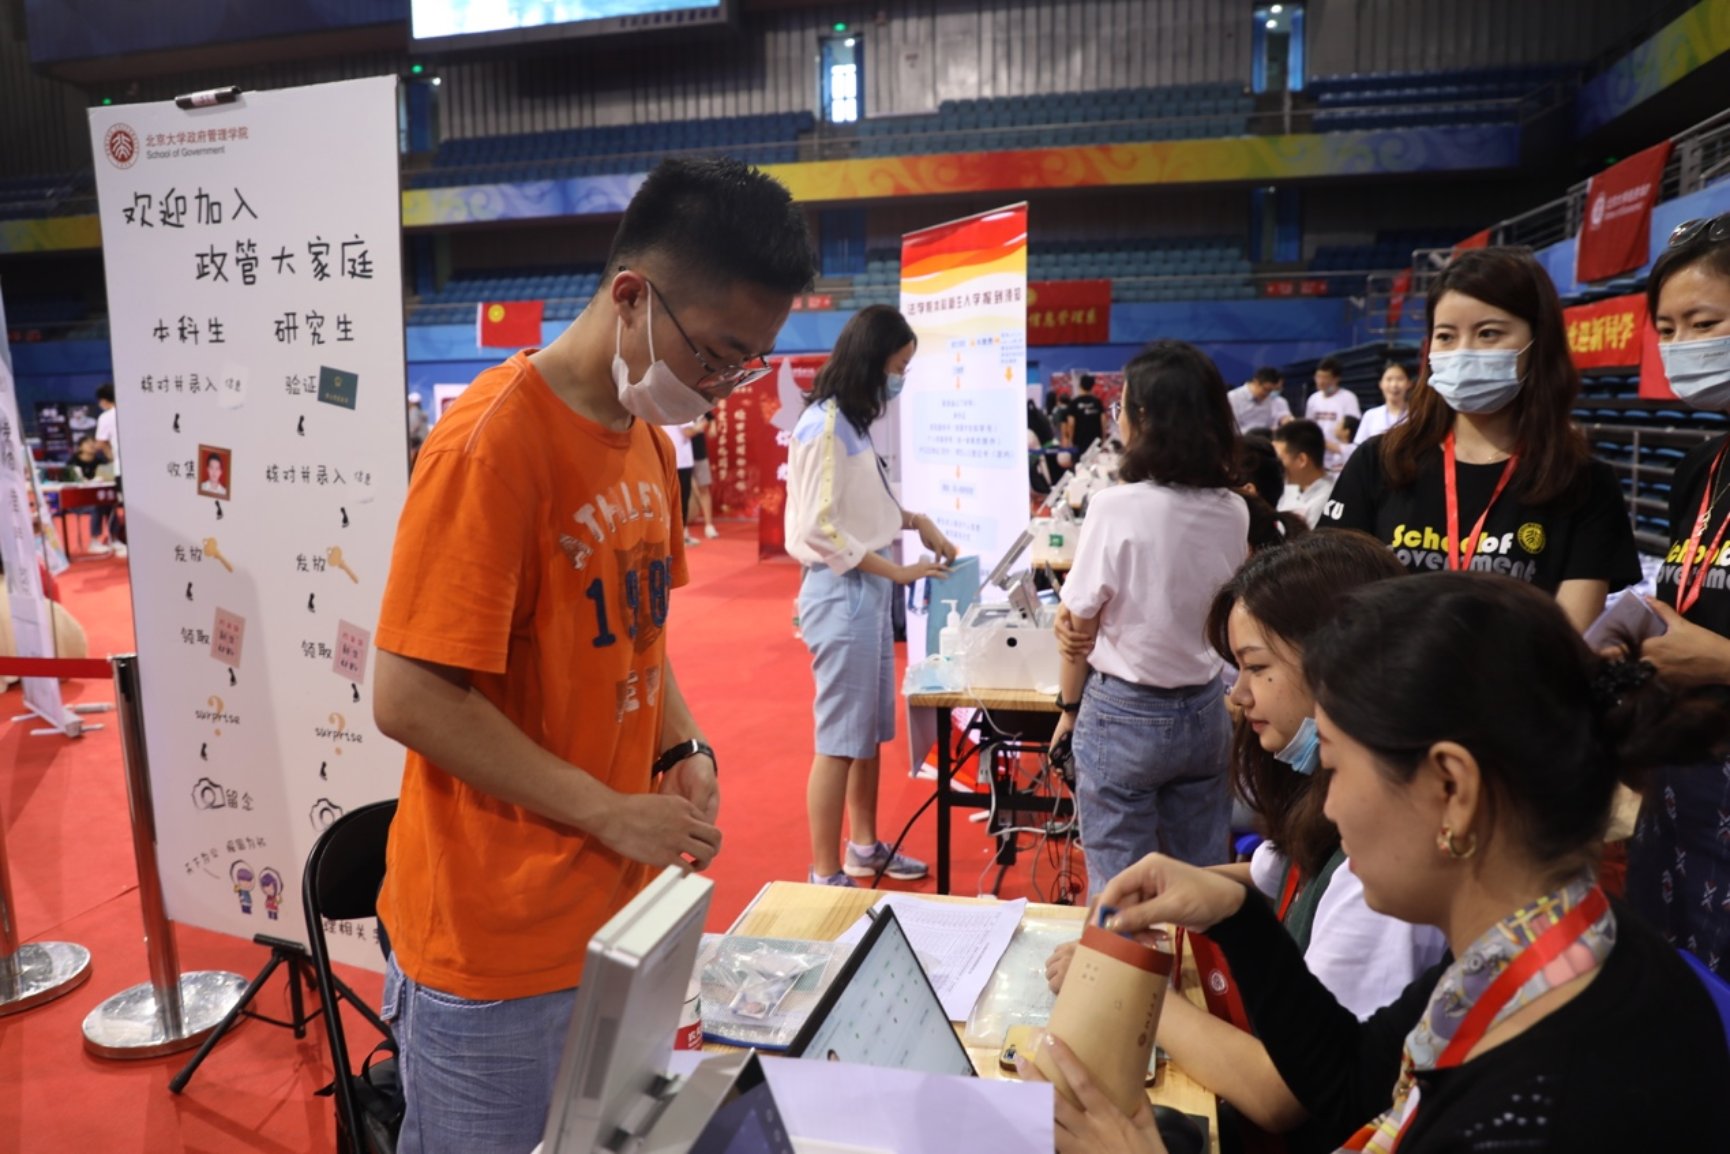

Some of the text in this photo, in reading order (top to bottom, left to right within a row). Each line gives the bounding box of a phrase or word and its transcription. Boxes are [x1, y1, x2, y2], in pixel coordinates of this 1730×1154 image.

[145, 126, 249, 148] 北京大学政府管理学院
[146, 146, 225, 160] School of Government
[122, 187, 258, 228] 欢迎加入
[195, 234, 374, 286] 政管大家庭
[153, 314, 226, 345] 本科生
[273, 309, 355, 346] 研究生
[141, 372, 218, 394] 核对并录入
[285, 373, 317, 395] 验证
[167, 459, 196, 480] 收集
[265, 463, 346, 486] 核对并录入
[174, 544, 203, 563] 发放
[1481, 532, 1514, 555] of
[295, 553, 326, 573] 发放
[181, 626, 210, 646] 领取
[301, 640, 332, 660] 领取
[195, 709, 241, 725] surprise
[314, 727, 364, 744] surprise
